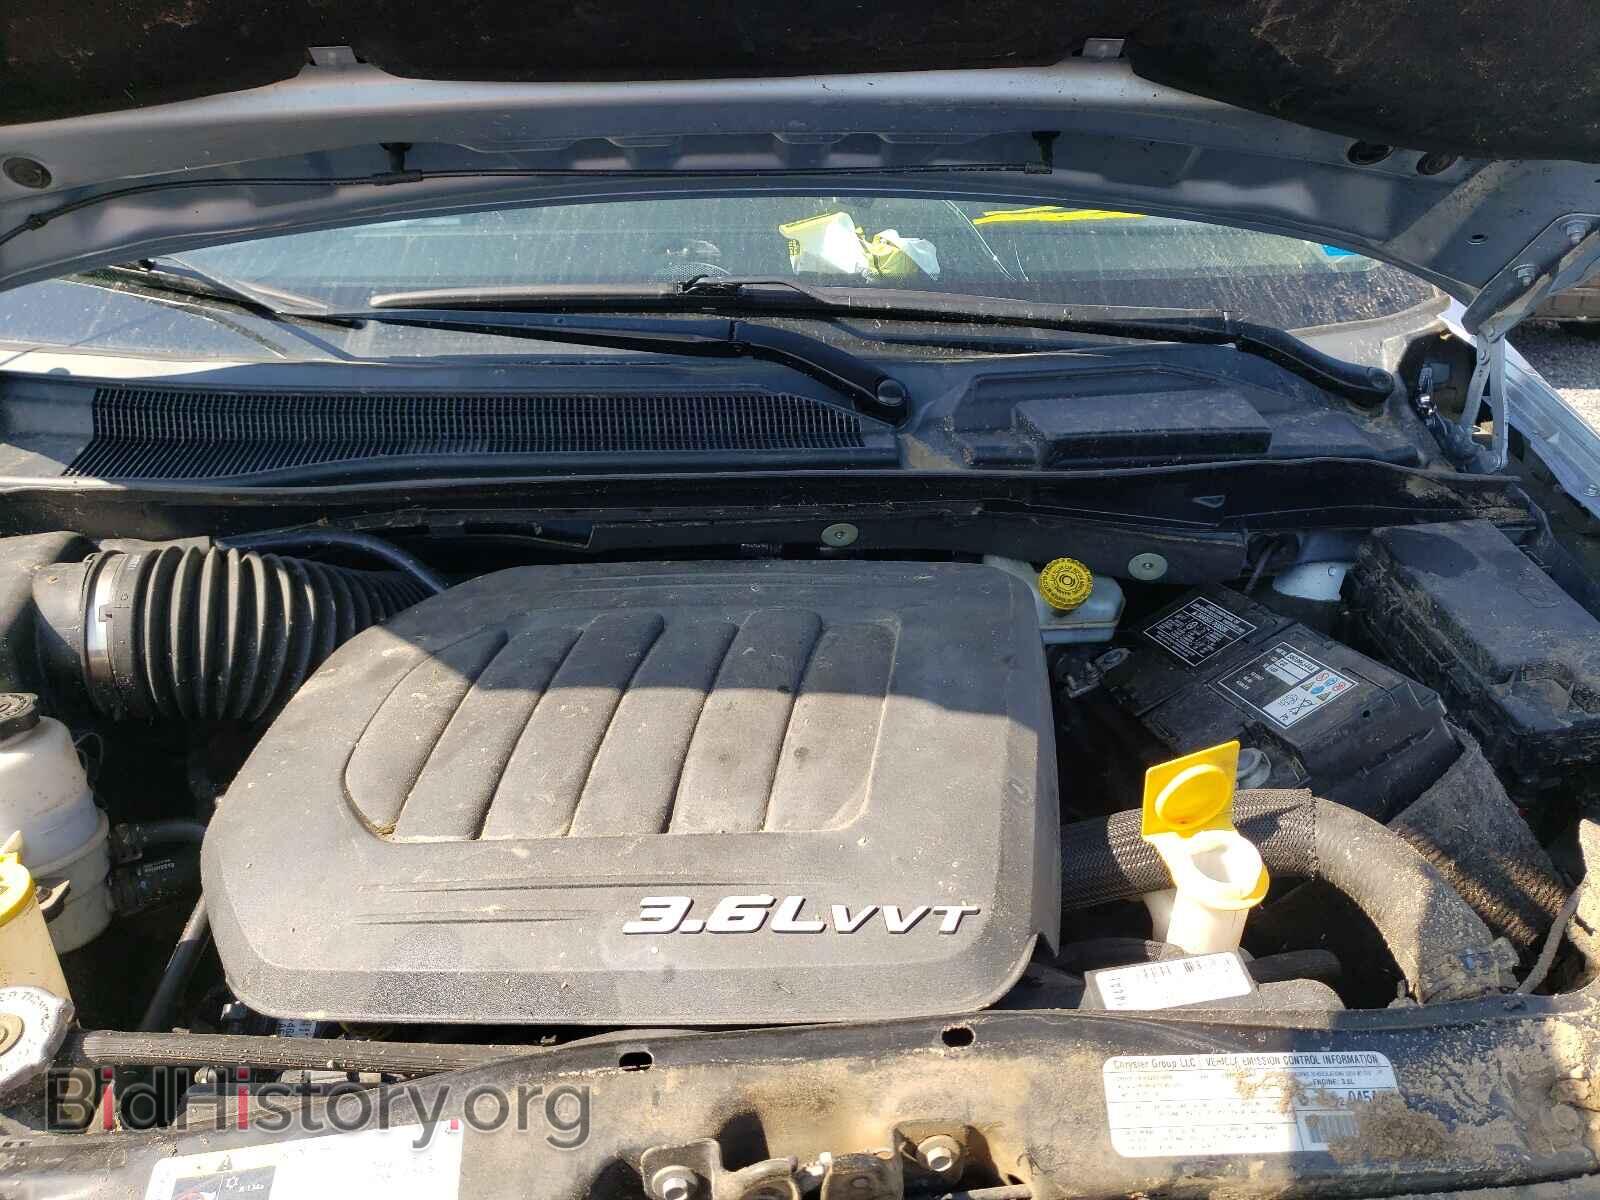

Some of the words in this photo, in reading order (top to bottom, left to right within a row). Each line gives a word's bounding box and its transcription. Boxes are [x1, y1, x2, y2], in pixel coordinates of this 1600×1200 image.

[1151, 1058, 1177, 1070] Group
[1242, 1054, 1281, 1066] EMISSION
[1283, 1054, 1321, 1065] CONTROL
[1322, 1053, 1378, 1065] INFORMATION
